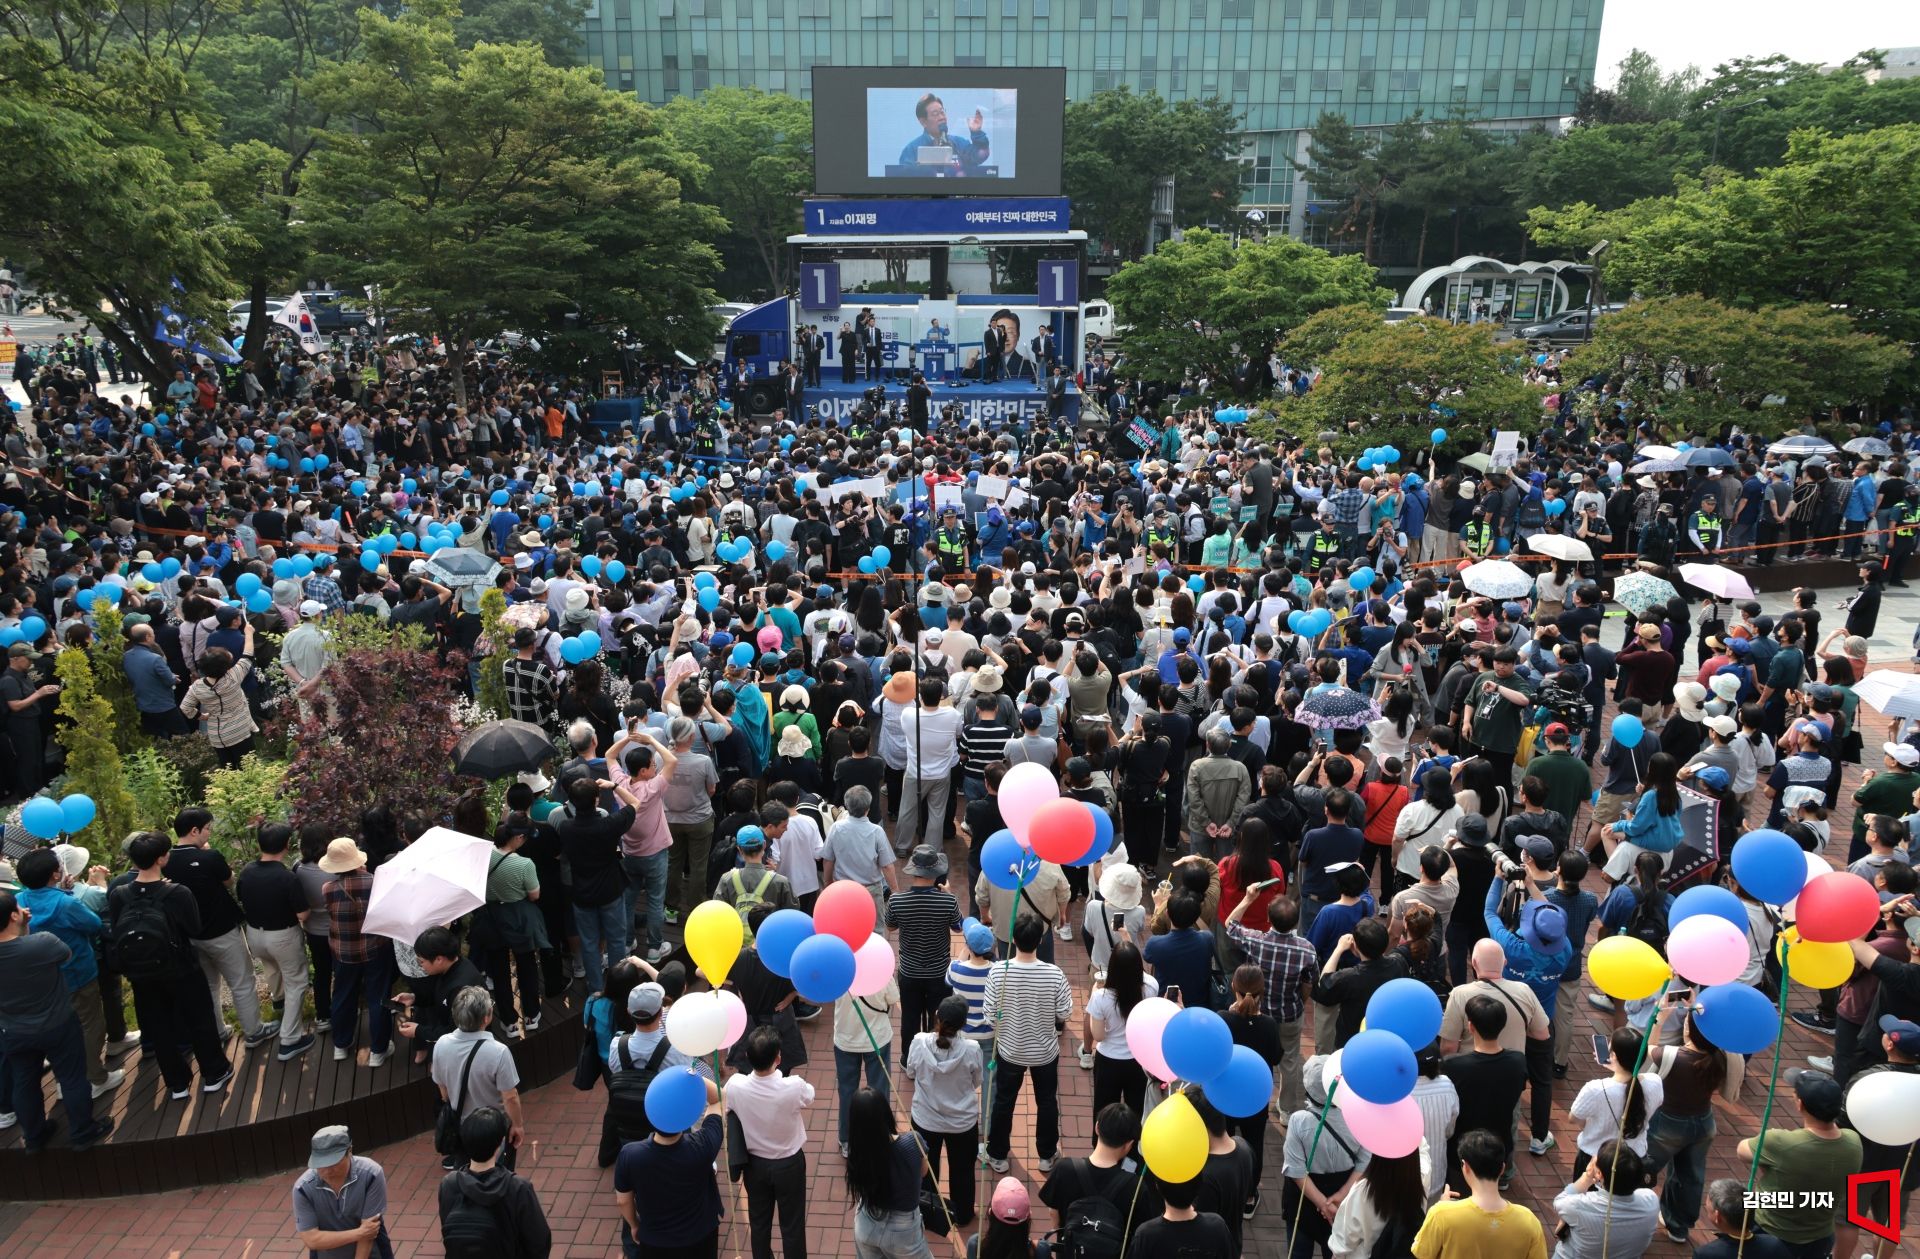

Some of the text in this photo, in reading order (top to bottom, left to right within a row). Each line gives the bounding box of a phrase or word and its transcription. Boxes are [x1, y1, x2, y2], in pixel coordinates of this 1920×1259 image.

[818, 209, 824, 225] 1
[844, 213, 877, 225] 이재명
[966, 211, 1057, 223] 이제부터 진짜 대한민국
[814, 269, 825, 303] 1
[1052, 266, 1063, 301] 1
[823, 332, 833, 359] 1
[932, 361, 937, 373] 1
